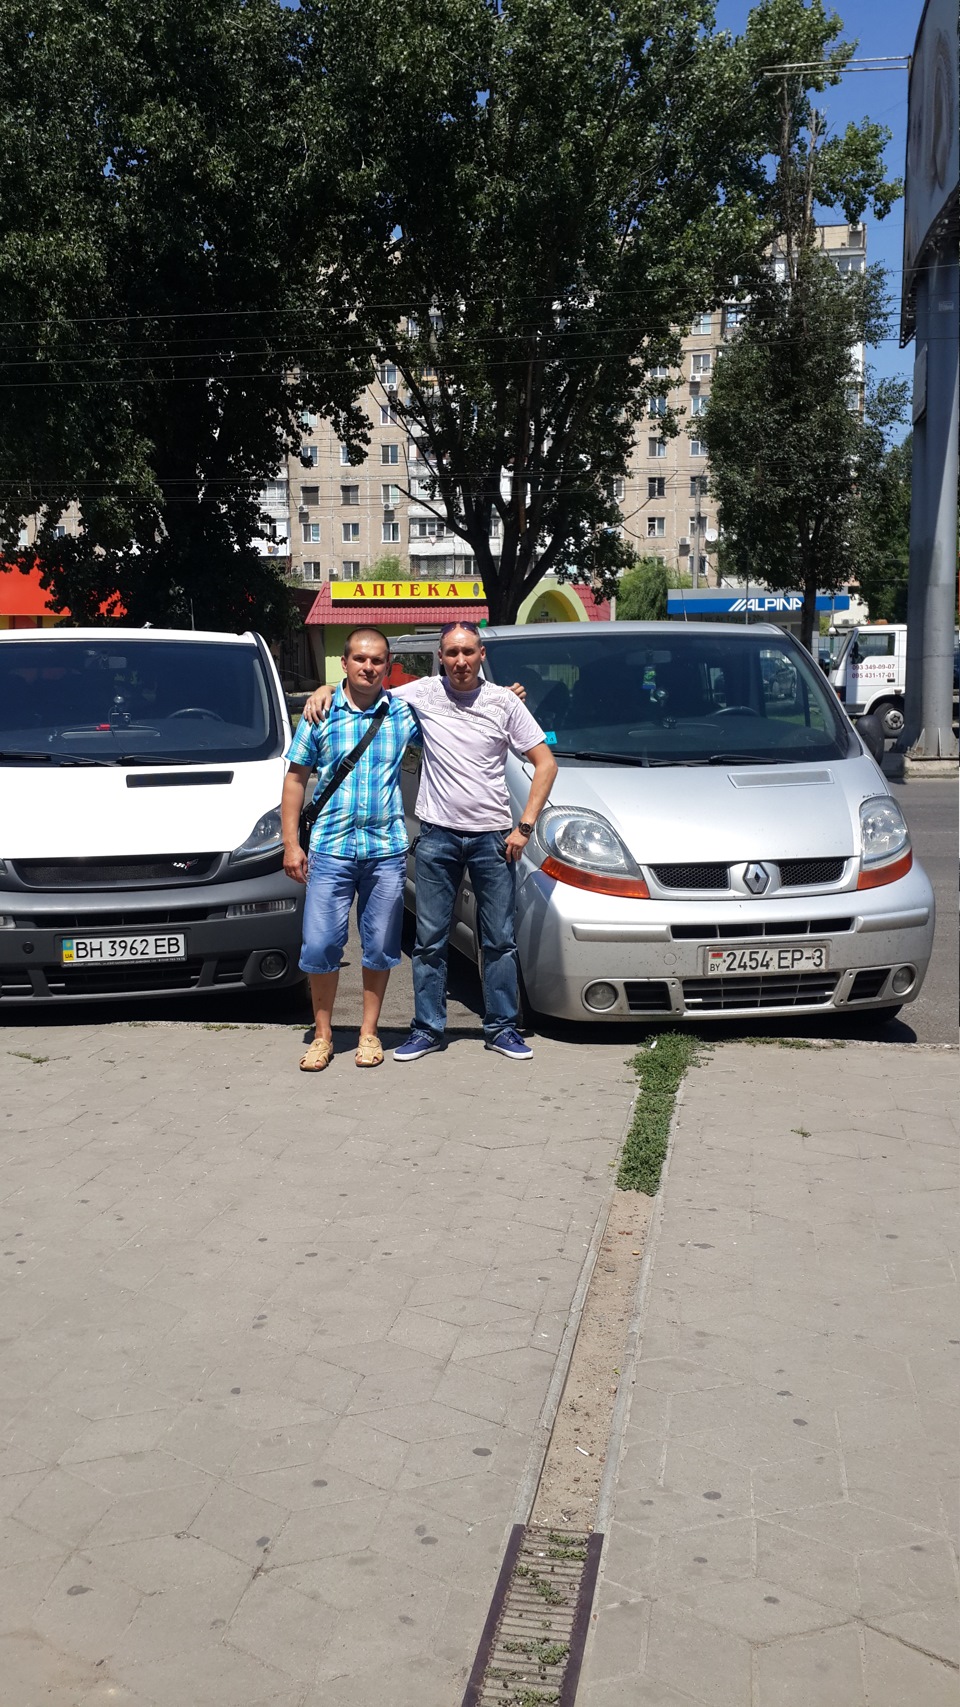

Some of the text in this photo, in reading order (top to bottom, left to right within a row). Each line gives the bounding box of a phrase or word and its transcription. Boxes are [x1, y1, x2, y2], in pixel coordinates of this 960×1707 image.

[353, 583, 459, 597] АПТЕКА
[75, 937, 181, 959] BH 3962 EB
[710, 963, 720, 972] BY
[725, 948, 823, 971] 2454 EP-3
